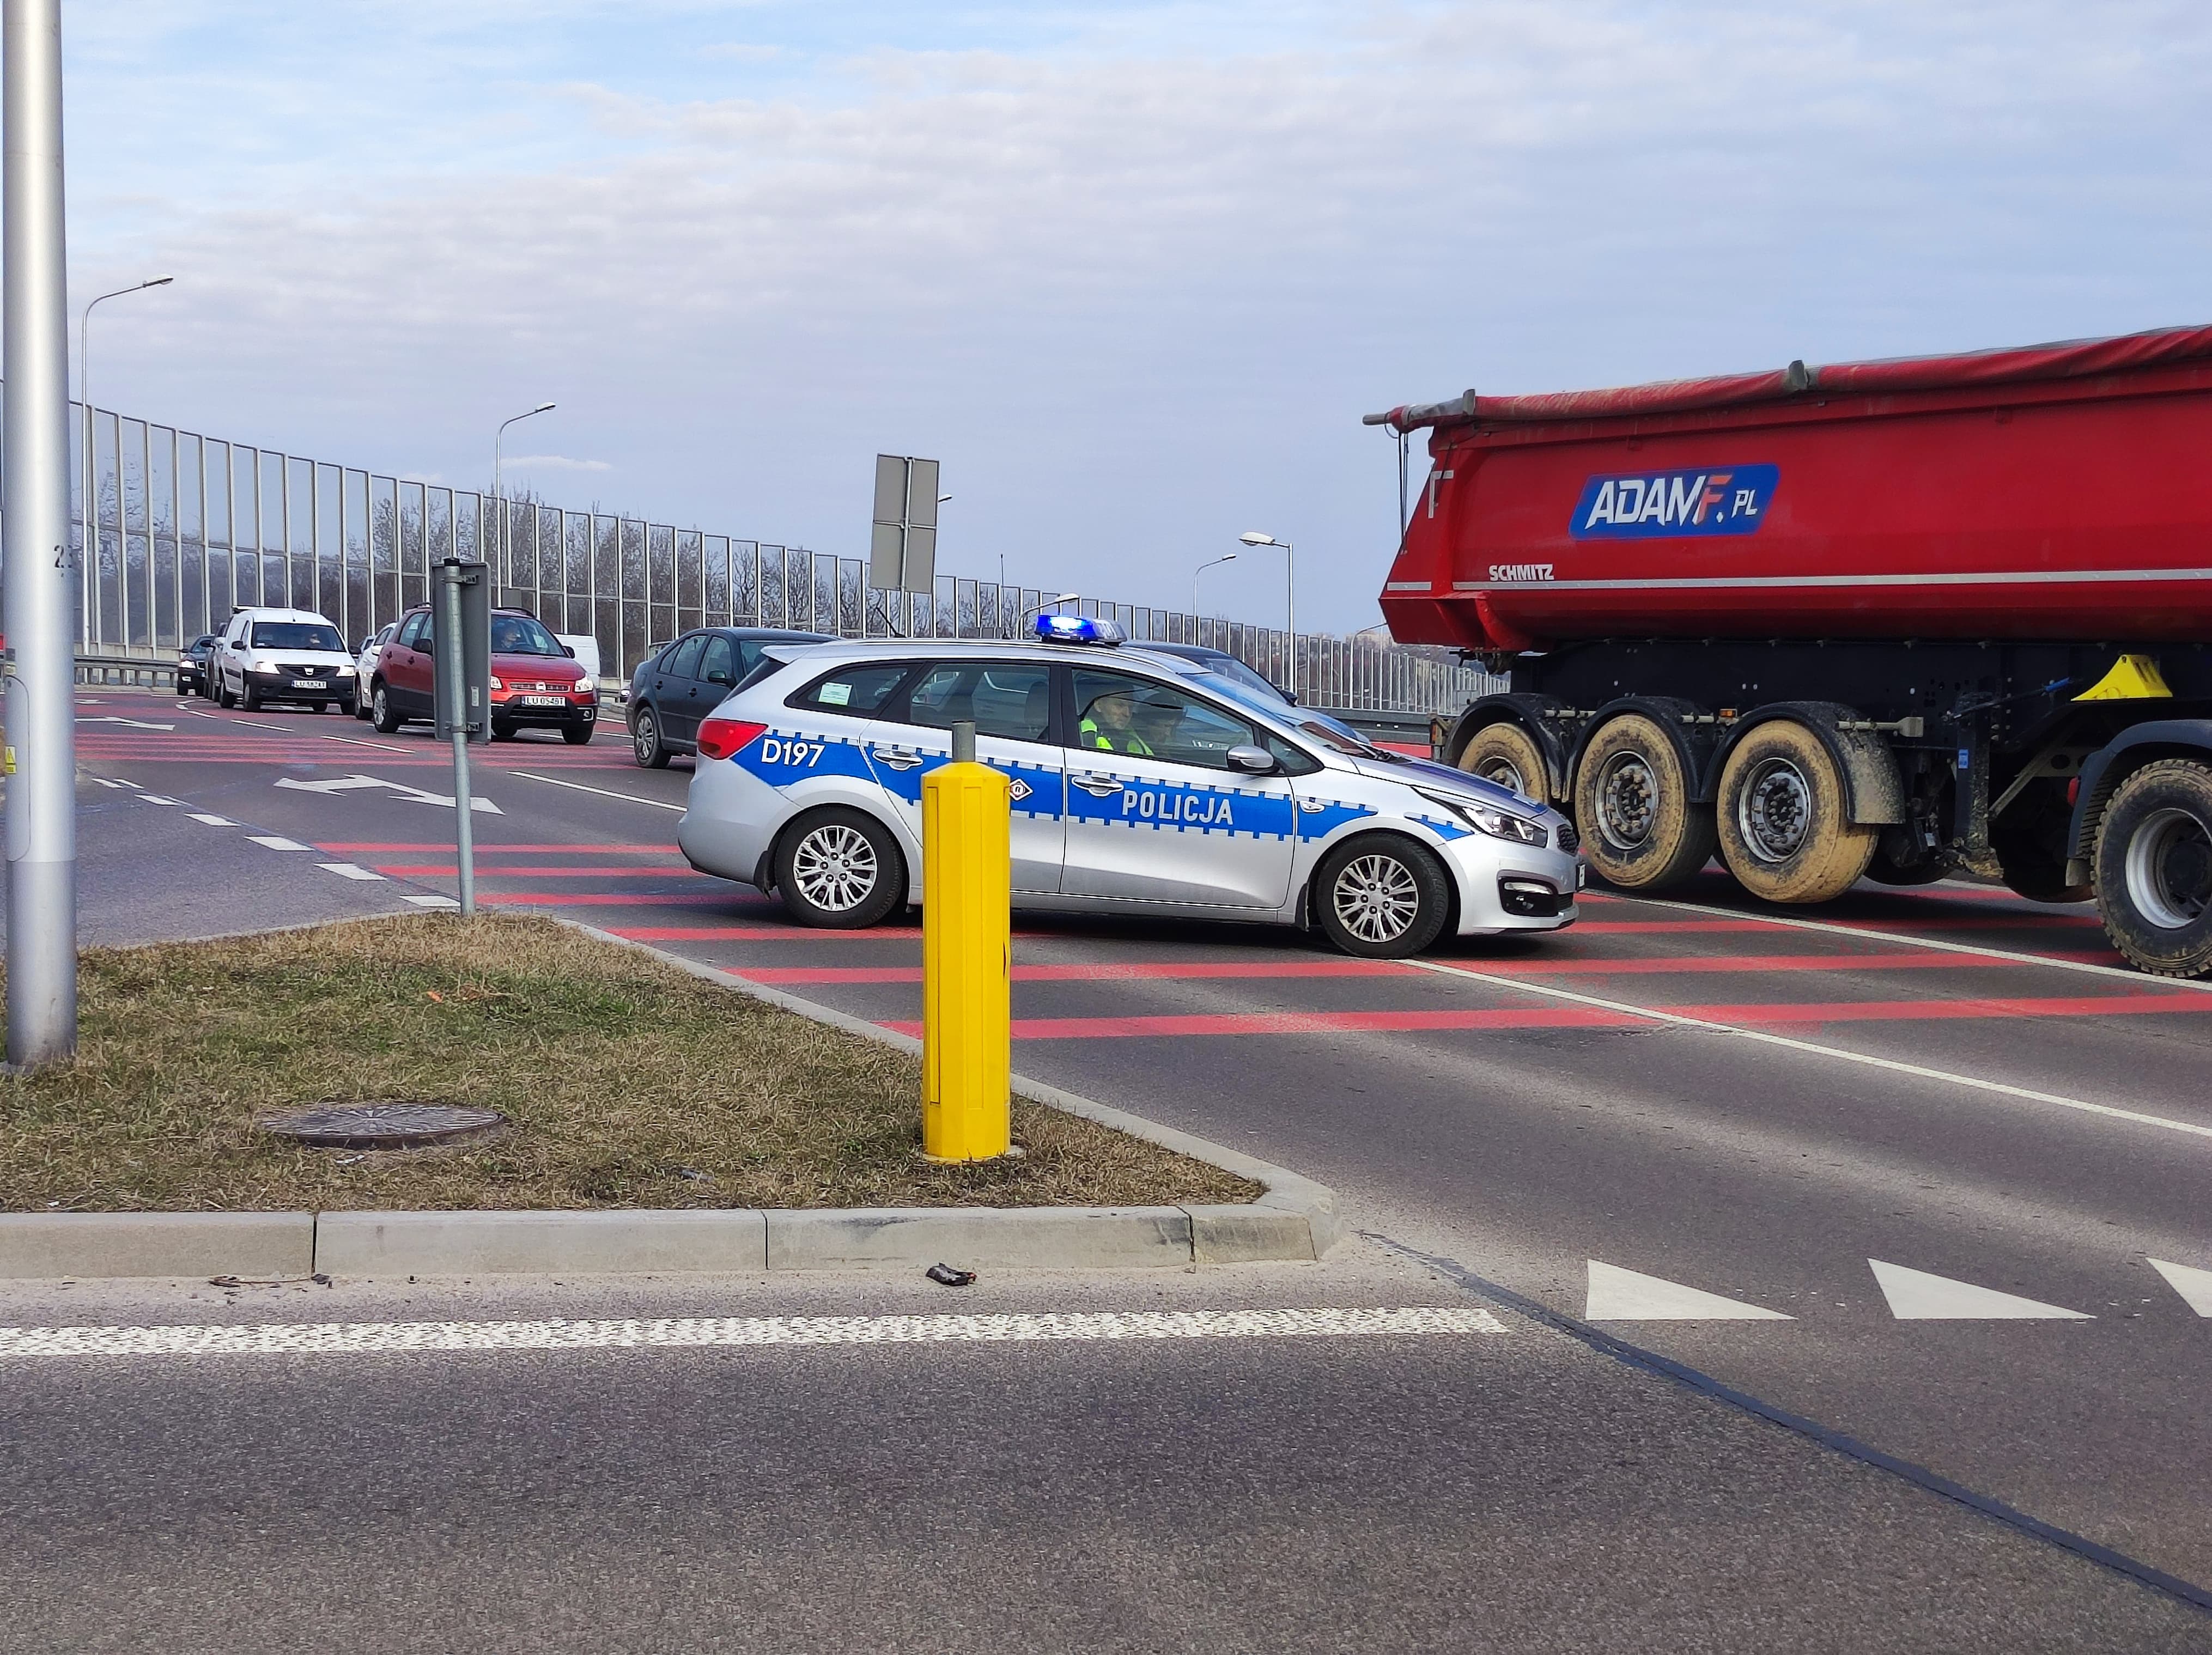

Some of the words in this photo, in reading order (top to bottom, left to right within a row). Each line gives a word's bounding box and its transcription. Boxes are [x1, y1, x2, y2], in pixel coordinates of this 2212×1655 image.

[1489, 564, 1554, 581] SCHMITZ
[761, 738, 825, 767] D197
[1122, 790, 1233, 825] POLICJA
